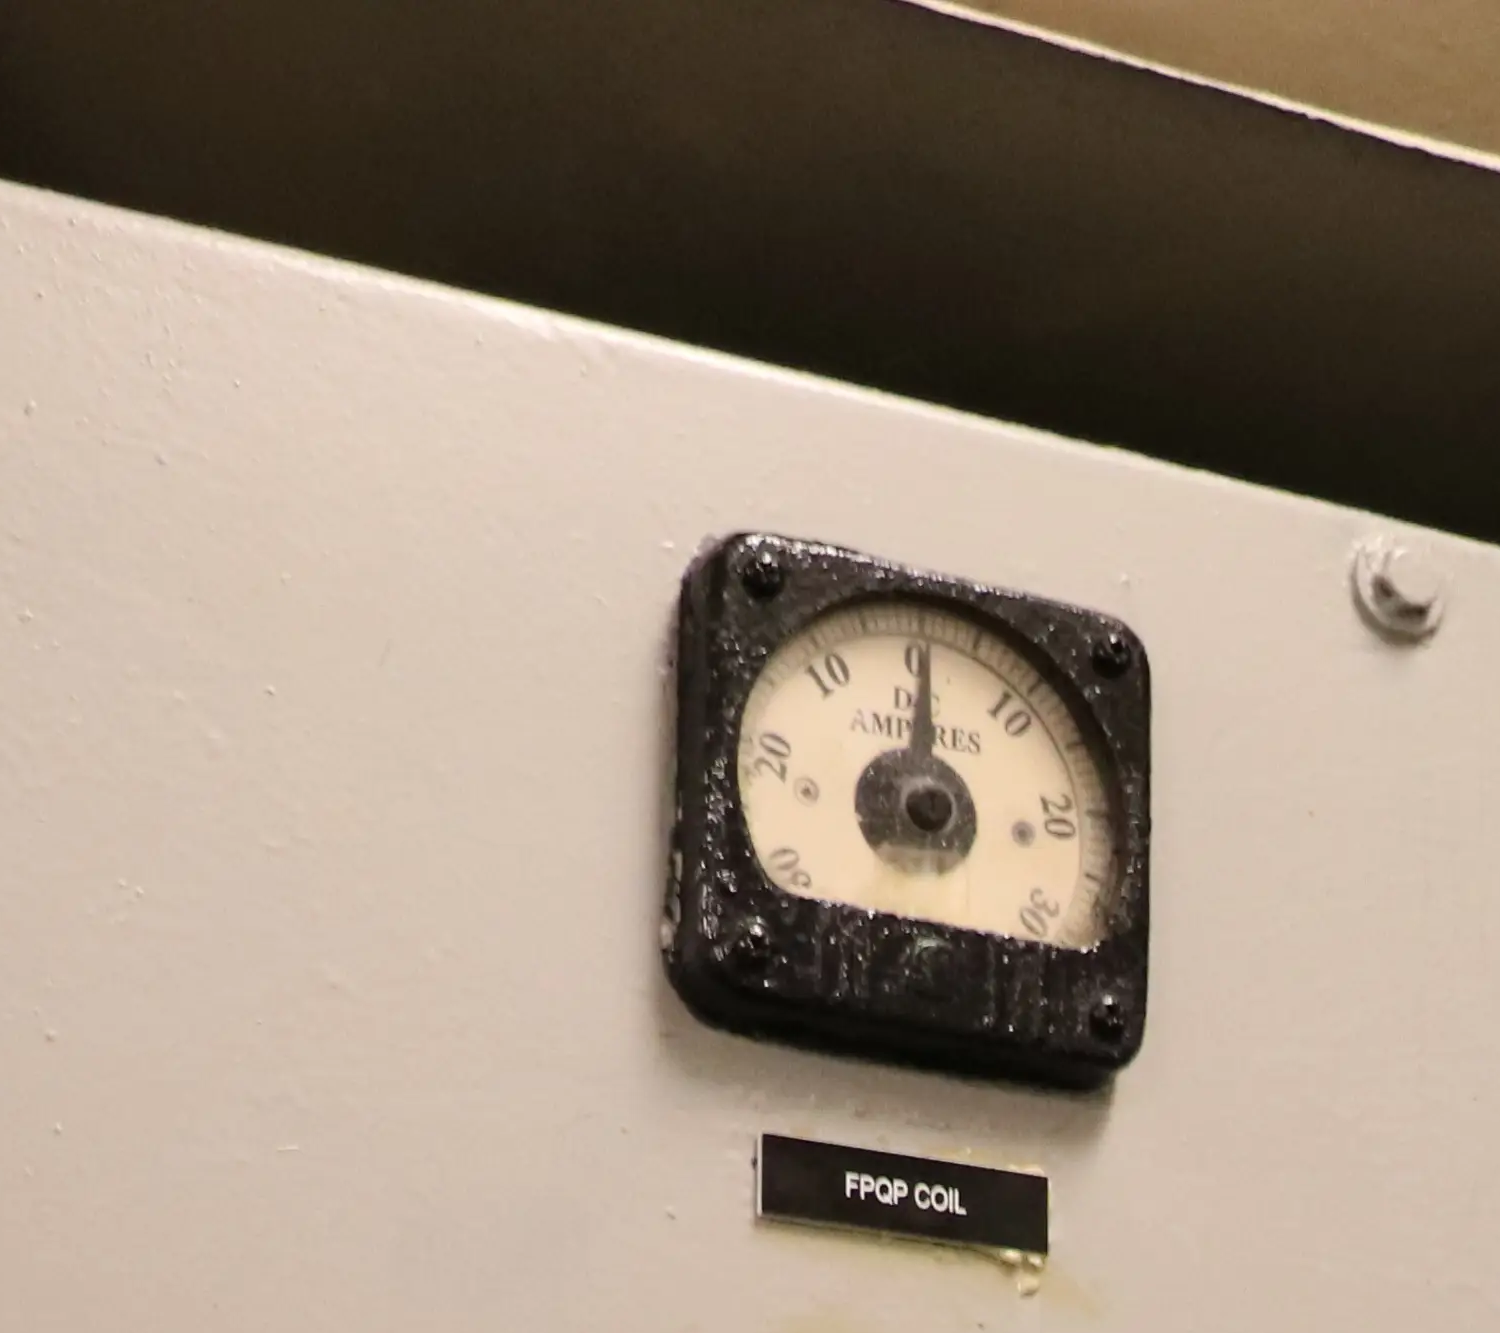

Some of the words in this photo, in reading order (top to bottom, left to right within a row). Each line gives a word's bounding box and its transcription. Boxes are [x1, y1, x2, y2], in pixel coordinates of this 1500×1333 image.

[804, 651, 851, 699] 10
[850, 709, 980, 753] AMPRES
[987, 692, 1031, 738] 10
[754, 732, 792, 784] 20
[1040, 793, 1077, 841] 20
[1019, 888, 1060, 938] 30
[845, 1171, 908, 1206] FPQP
[914, 1183, 967, 1216] COIL
